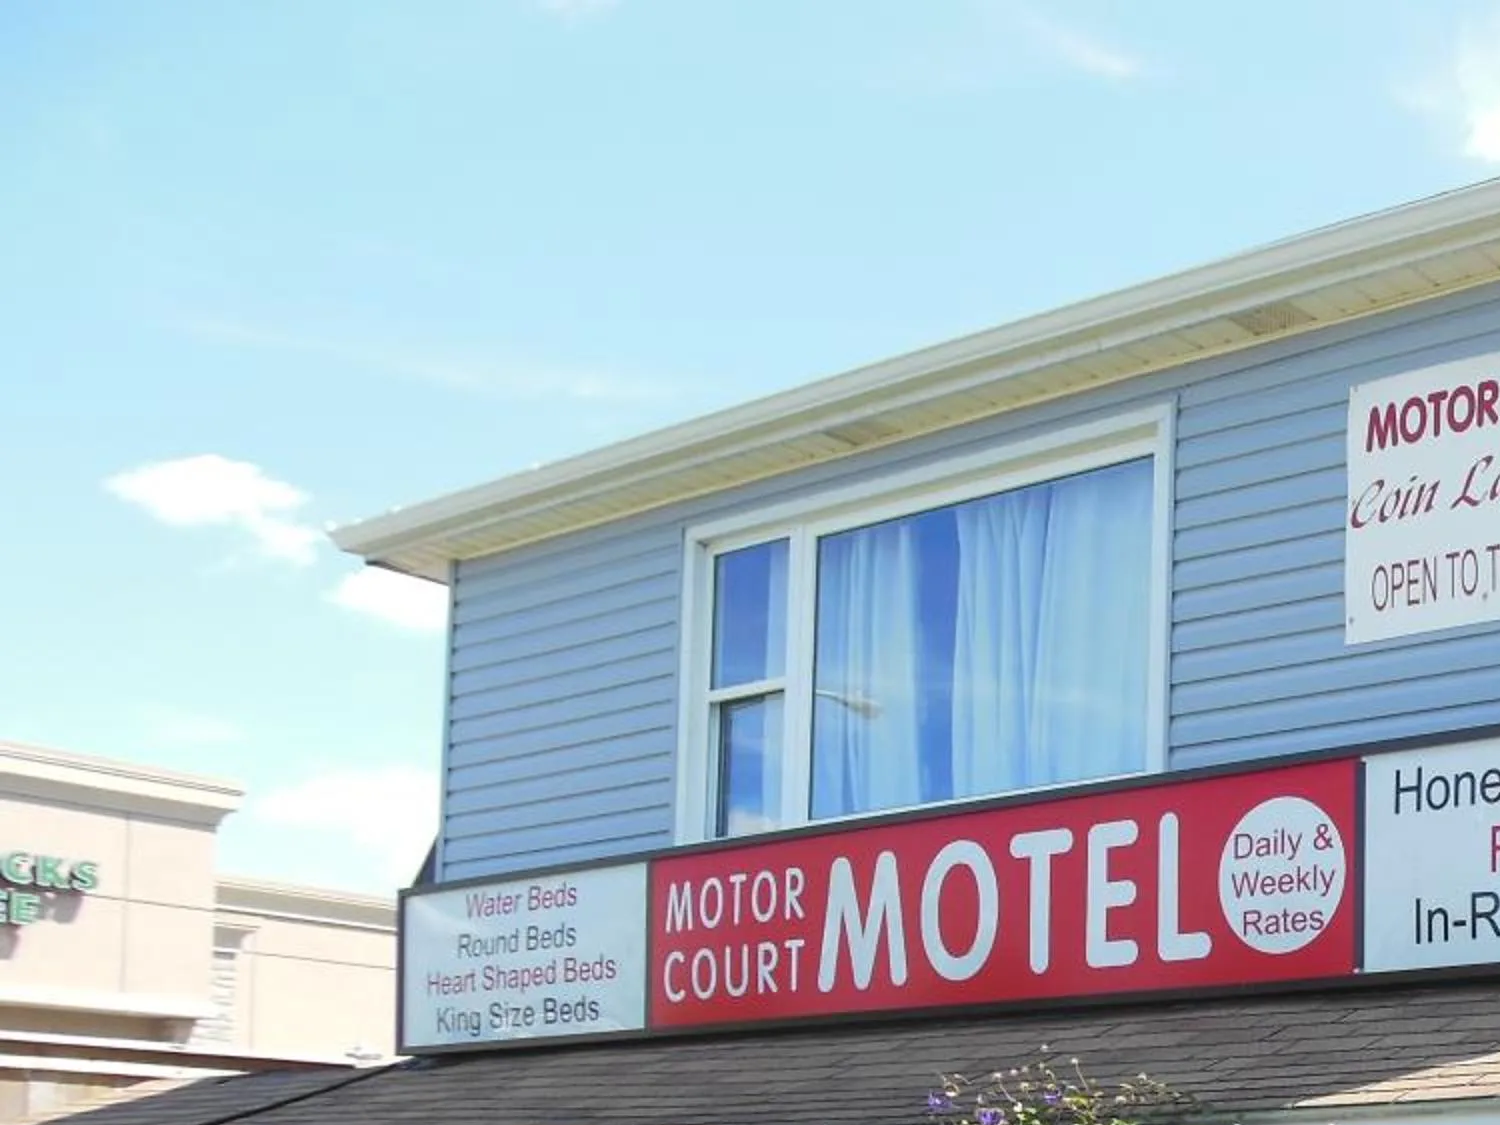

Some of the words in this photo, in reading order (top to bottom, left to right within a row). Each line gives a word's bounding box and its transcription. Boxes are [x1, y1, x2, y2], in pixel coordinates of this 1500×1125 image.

[1366, 379, 1499, 452] MOTOR
[1351, 475, 1440, 529] Coin
[1371, 557, 1438, 611] OPEN
[1446, 549, 1479, 599] TO
[1233, 828, 1303, 861] Daily
[1313, 823, 1334, 850] &
[465, 891, 524, 919] Water
[527, 881, 577, 912] Beds
[666, 867, 806, 934] MOTOR
[817, 812, 1211, 993] MOTEL
[1231, 864, 1336, 899] Weekly
[456, 928, 519, 960] Round
[525, 922, 577, 951] Beds
[1242, 908, 1326, 936] Rates
[427, 969, 477, 997] Heart
[482, 959, 558, 993] Shaped
[563, 954, 617, 984] Beds
[663, 938, 805, 1003] COURT
[436, 1006, 482, 1037] King
[489, 1001, 535, 1029] Size
[543, 996, 600, 1025] Beds
